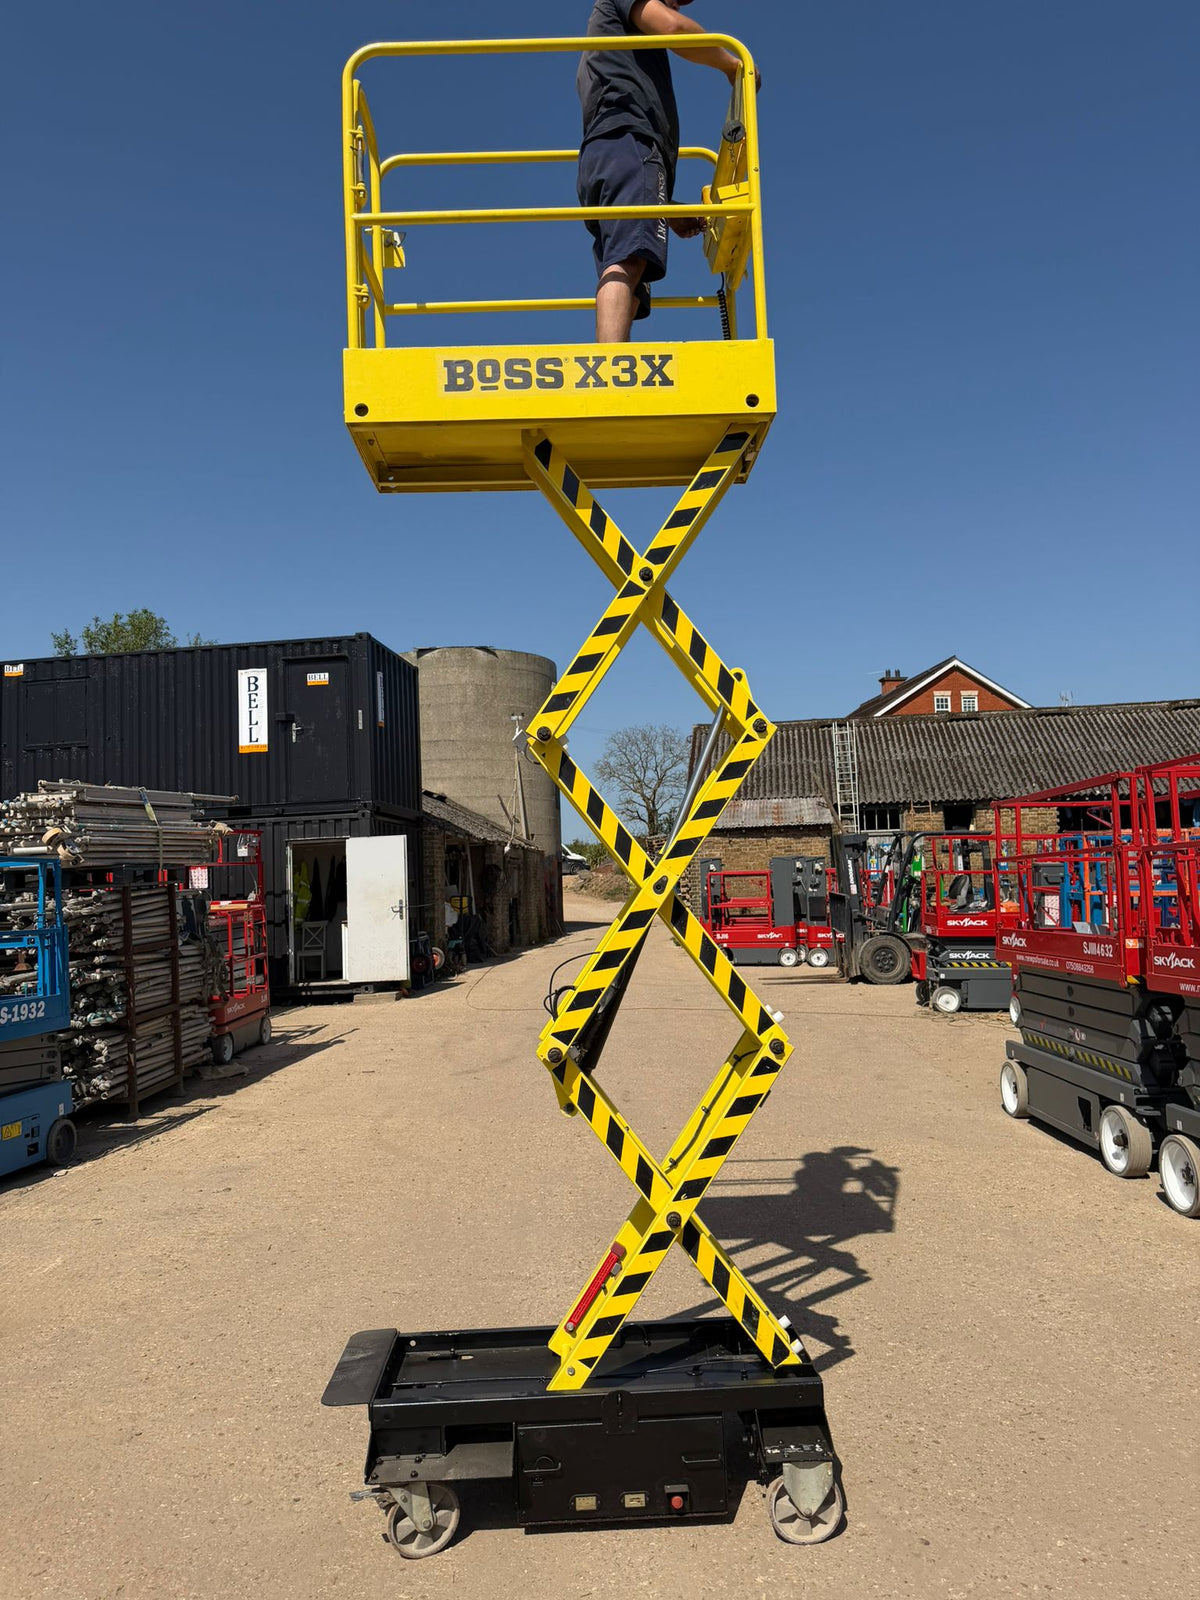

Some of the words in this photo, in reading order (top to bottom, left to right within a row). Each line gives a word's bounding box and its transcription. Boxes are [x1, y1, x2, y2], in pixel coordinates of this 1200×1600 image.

[574, 354, 674, 388] X3X
[247, 676, 259, 743] BELL
[946, 918, 988, 927] SKYJACK
[1001, 932, 1028, 948] SKYJACK
[949, 951, 990, 959] SKYJACK
[1153, 952, 1196, 969] SKYJACK
